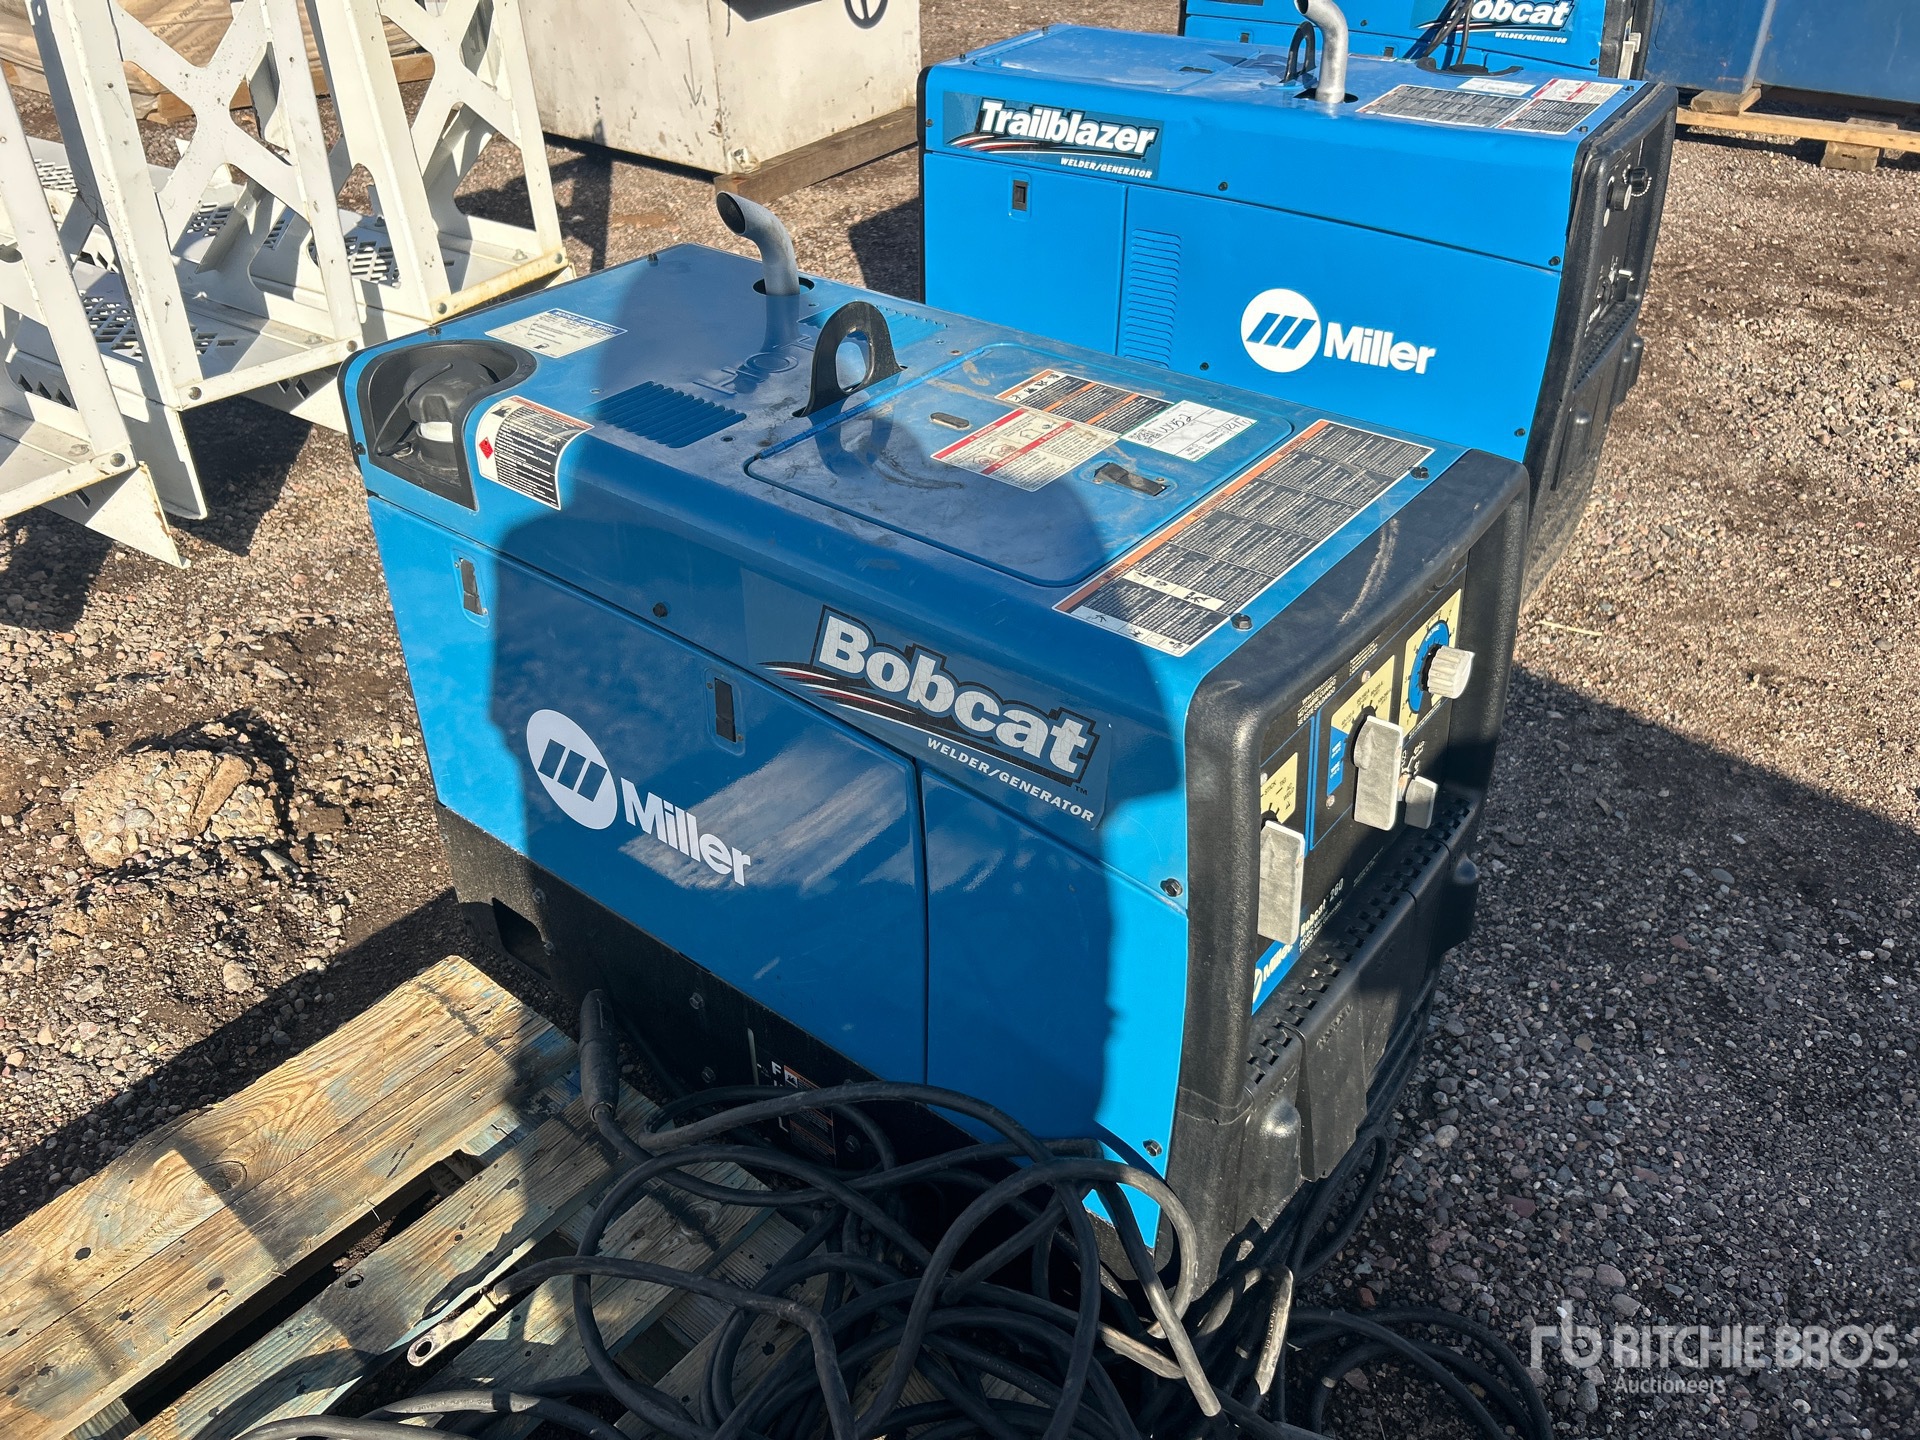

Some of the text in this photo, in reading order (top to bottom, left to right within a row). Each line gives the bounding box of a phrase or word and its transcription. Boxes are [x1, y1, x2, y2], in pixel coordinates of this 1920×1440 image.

[1450, 0, 1570, 26] obcat
[1495, 31, 1568, 44] WELDER/GENERATOR
[980, 98, 1156, 156] Trailblazer
[1060, 156, 1153, 180] WELDER/GENERATOR
[1323, 324, 1436, 375] Miller
[818, 614, 1087, 774] Bobcat
[927, 736, 1095, 823] WELDER/GENERATOR
[620, 777, 751, 887] Miller
[1300, 877, 1344, 938] Bobcat 260
